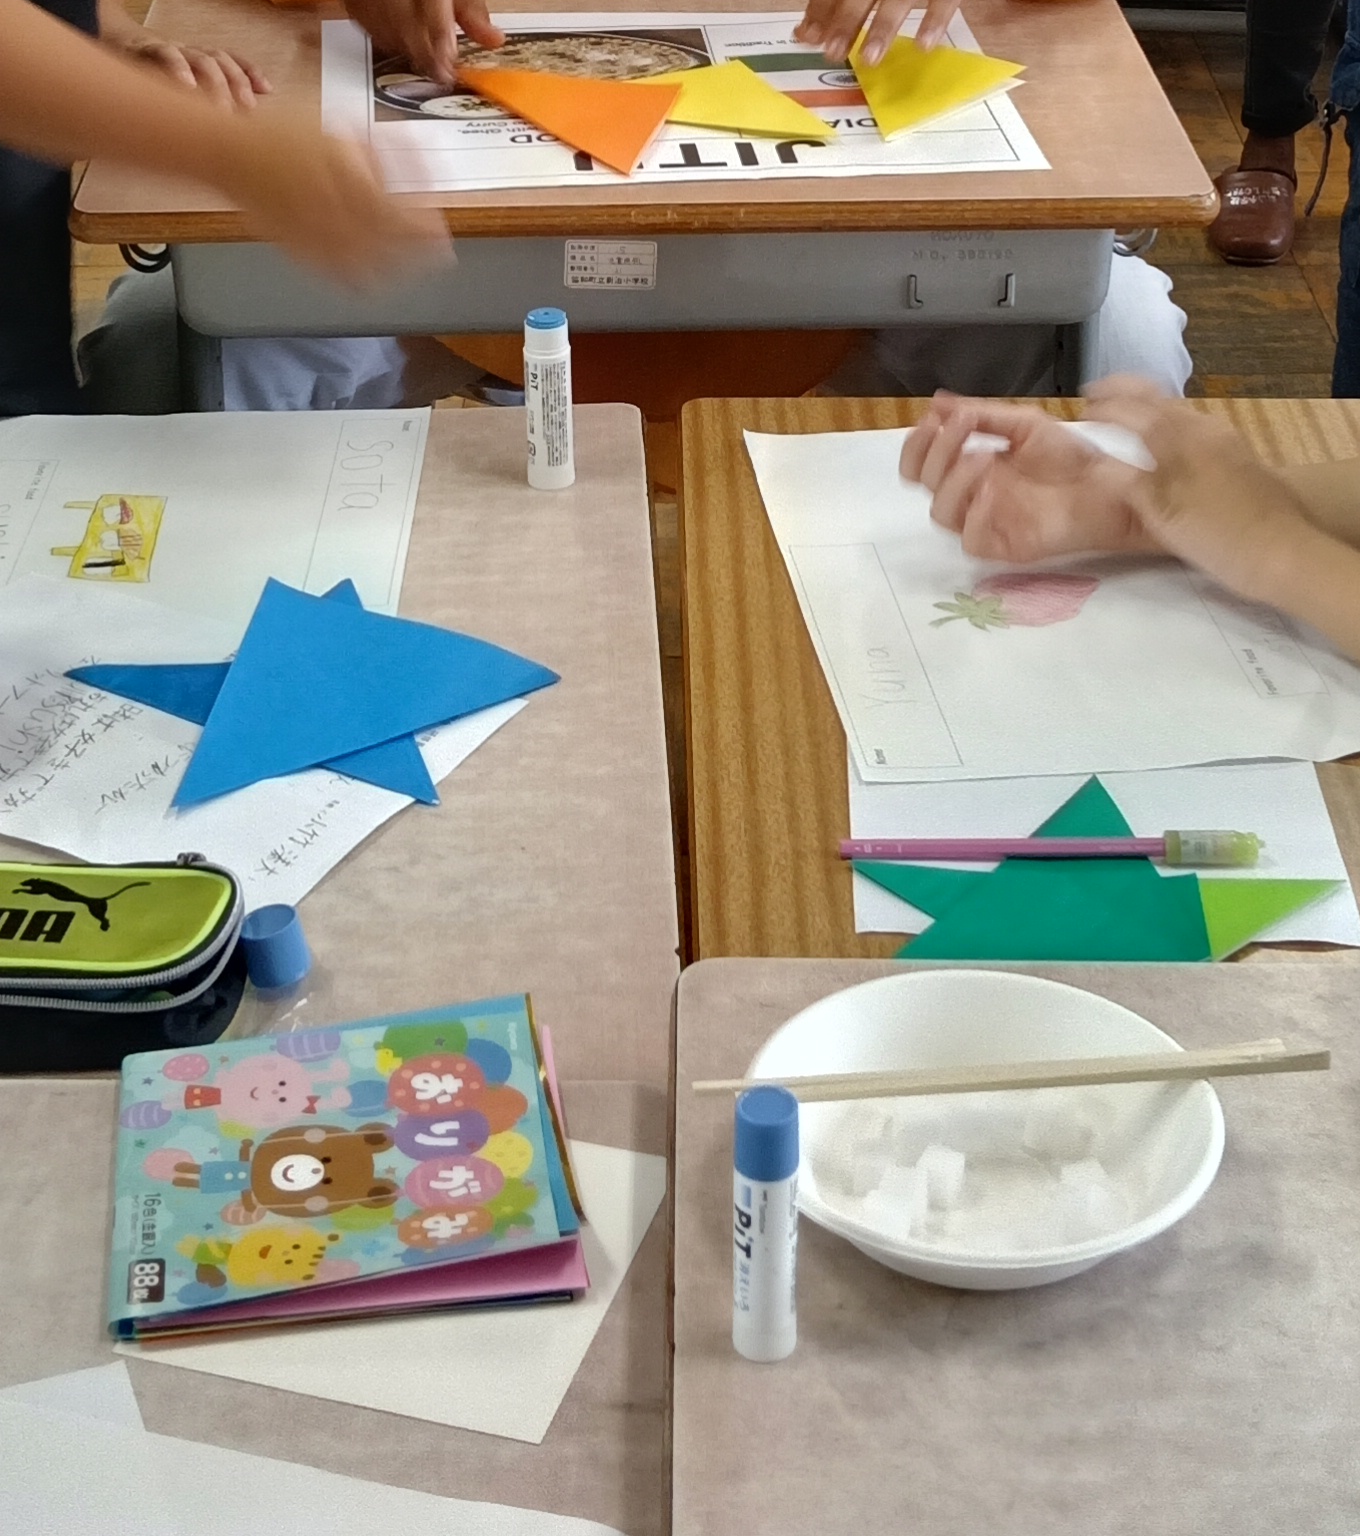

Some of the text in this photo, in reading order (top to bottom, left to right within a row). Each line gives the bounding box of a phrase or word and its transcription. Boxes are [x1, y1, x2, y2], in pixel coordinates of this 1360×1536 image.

[822, 117, 878, 129] DIA
[509, 133, 560, 144] OD
[734, 1202, 756, 1260] PiT
